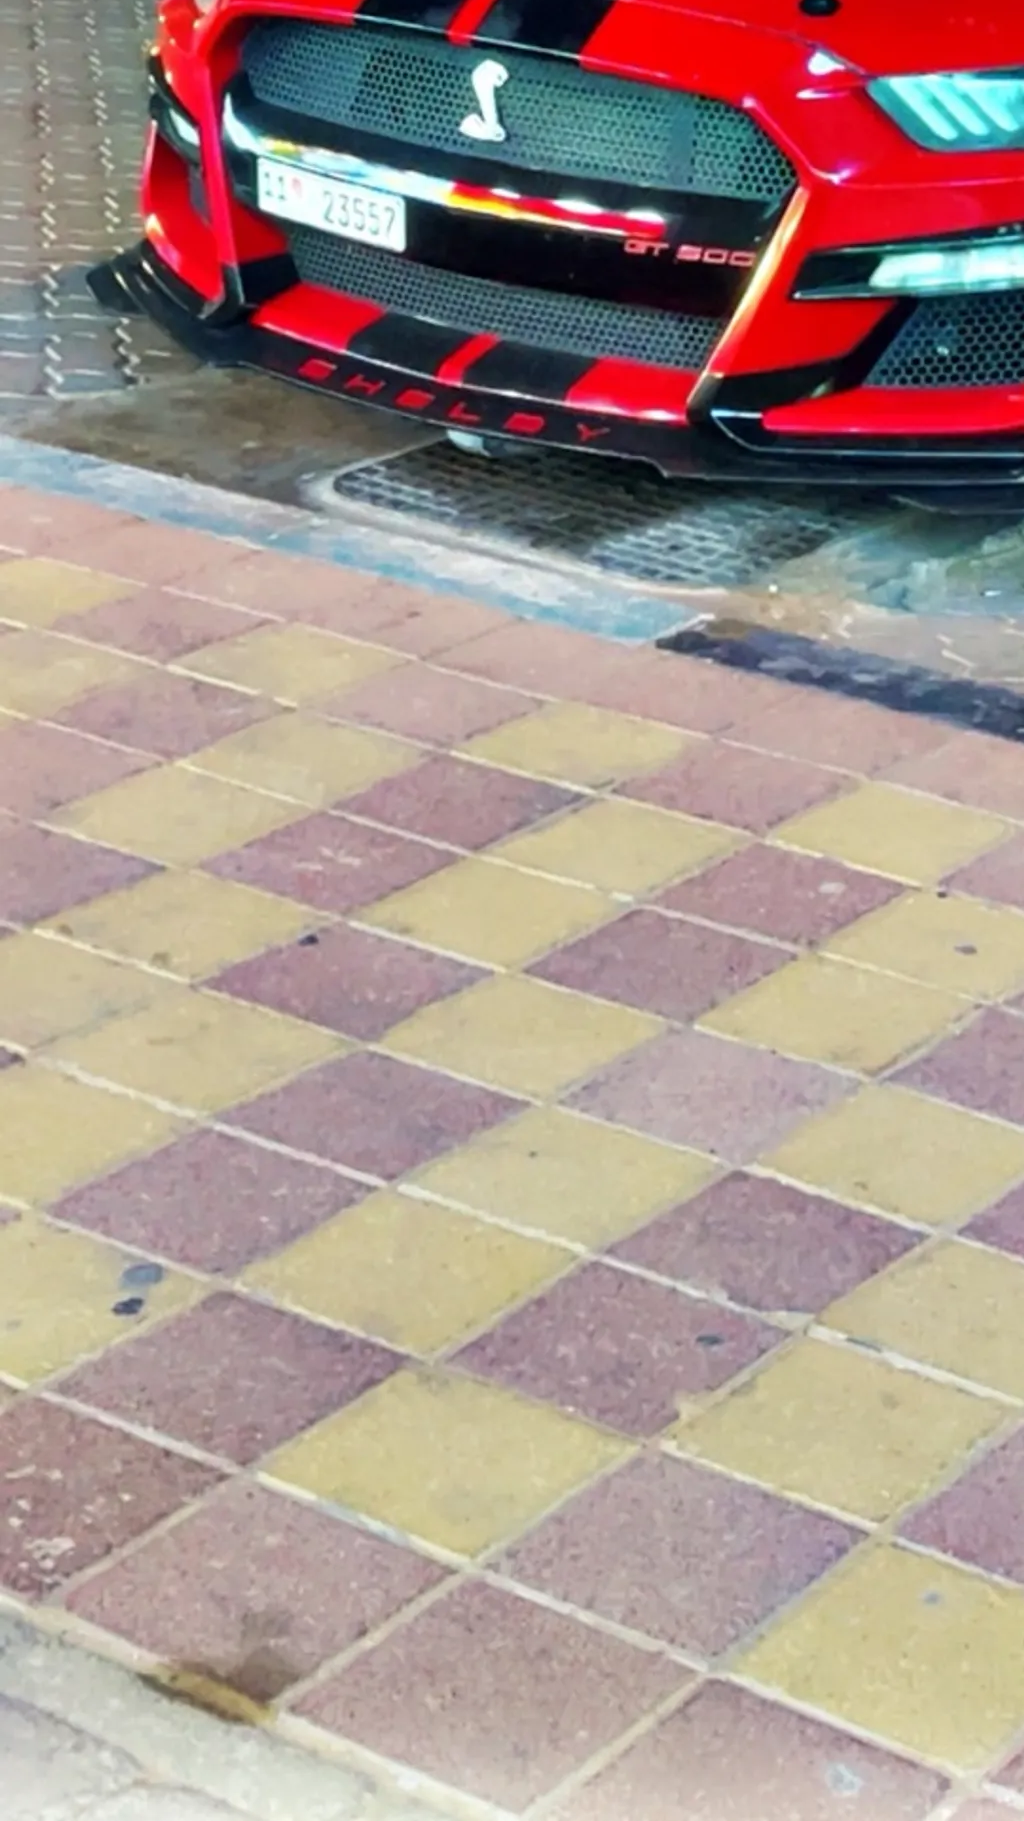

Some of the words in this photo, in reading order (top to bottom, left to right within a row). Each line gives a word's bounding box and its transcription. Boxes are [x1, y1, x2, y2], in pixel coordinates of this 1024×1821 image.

[321, 189, 397, 240] 23557
[624, 238, 669, 257] GT
[298, 357, 611, 442] SHELBY
